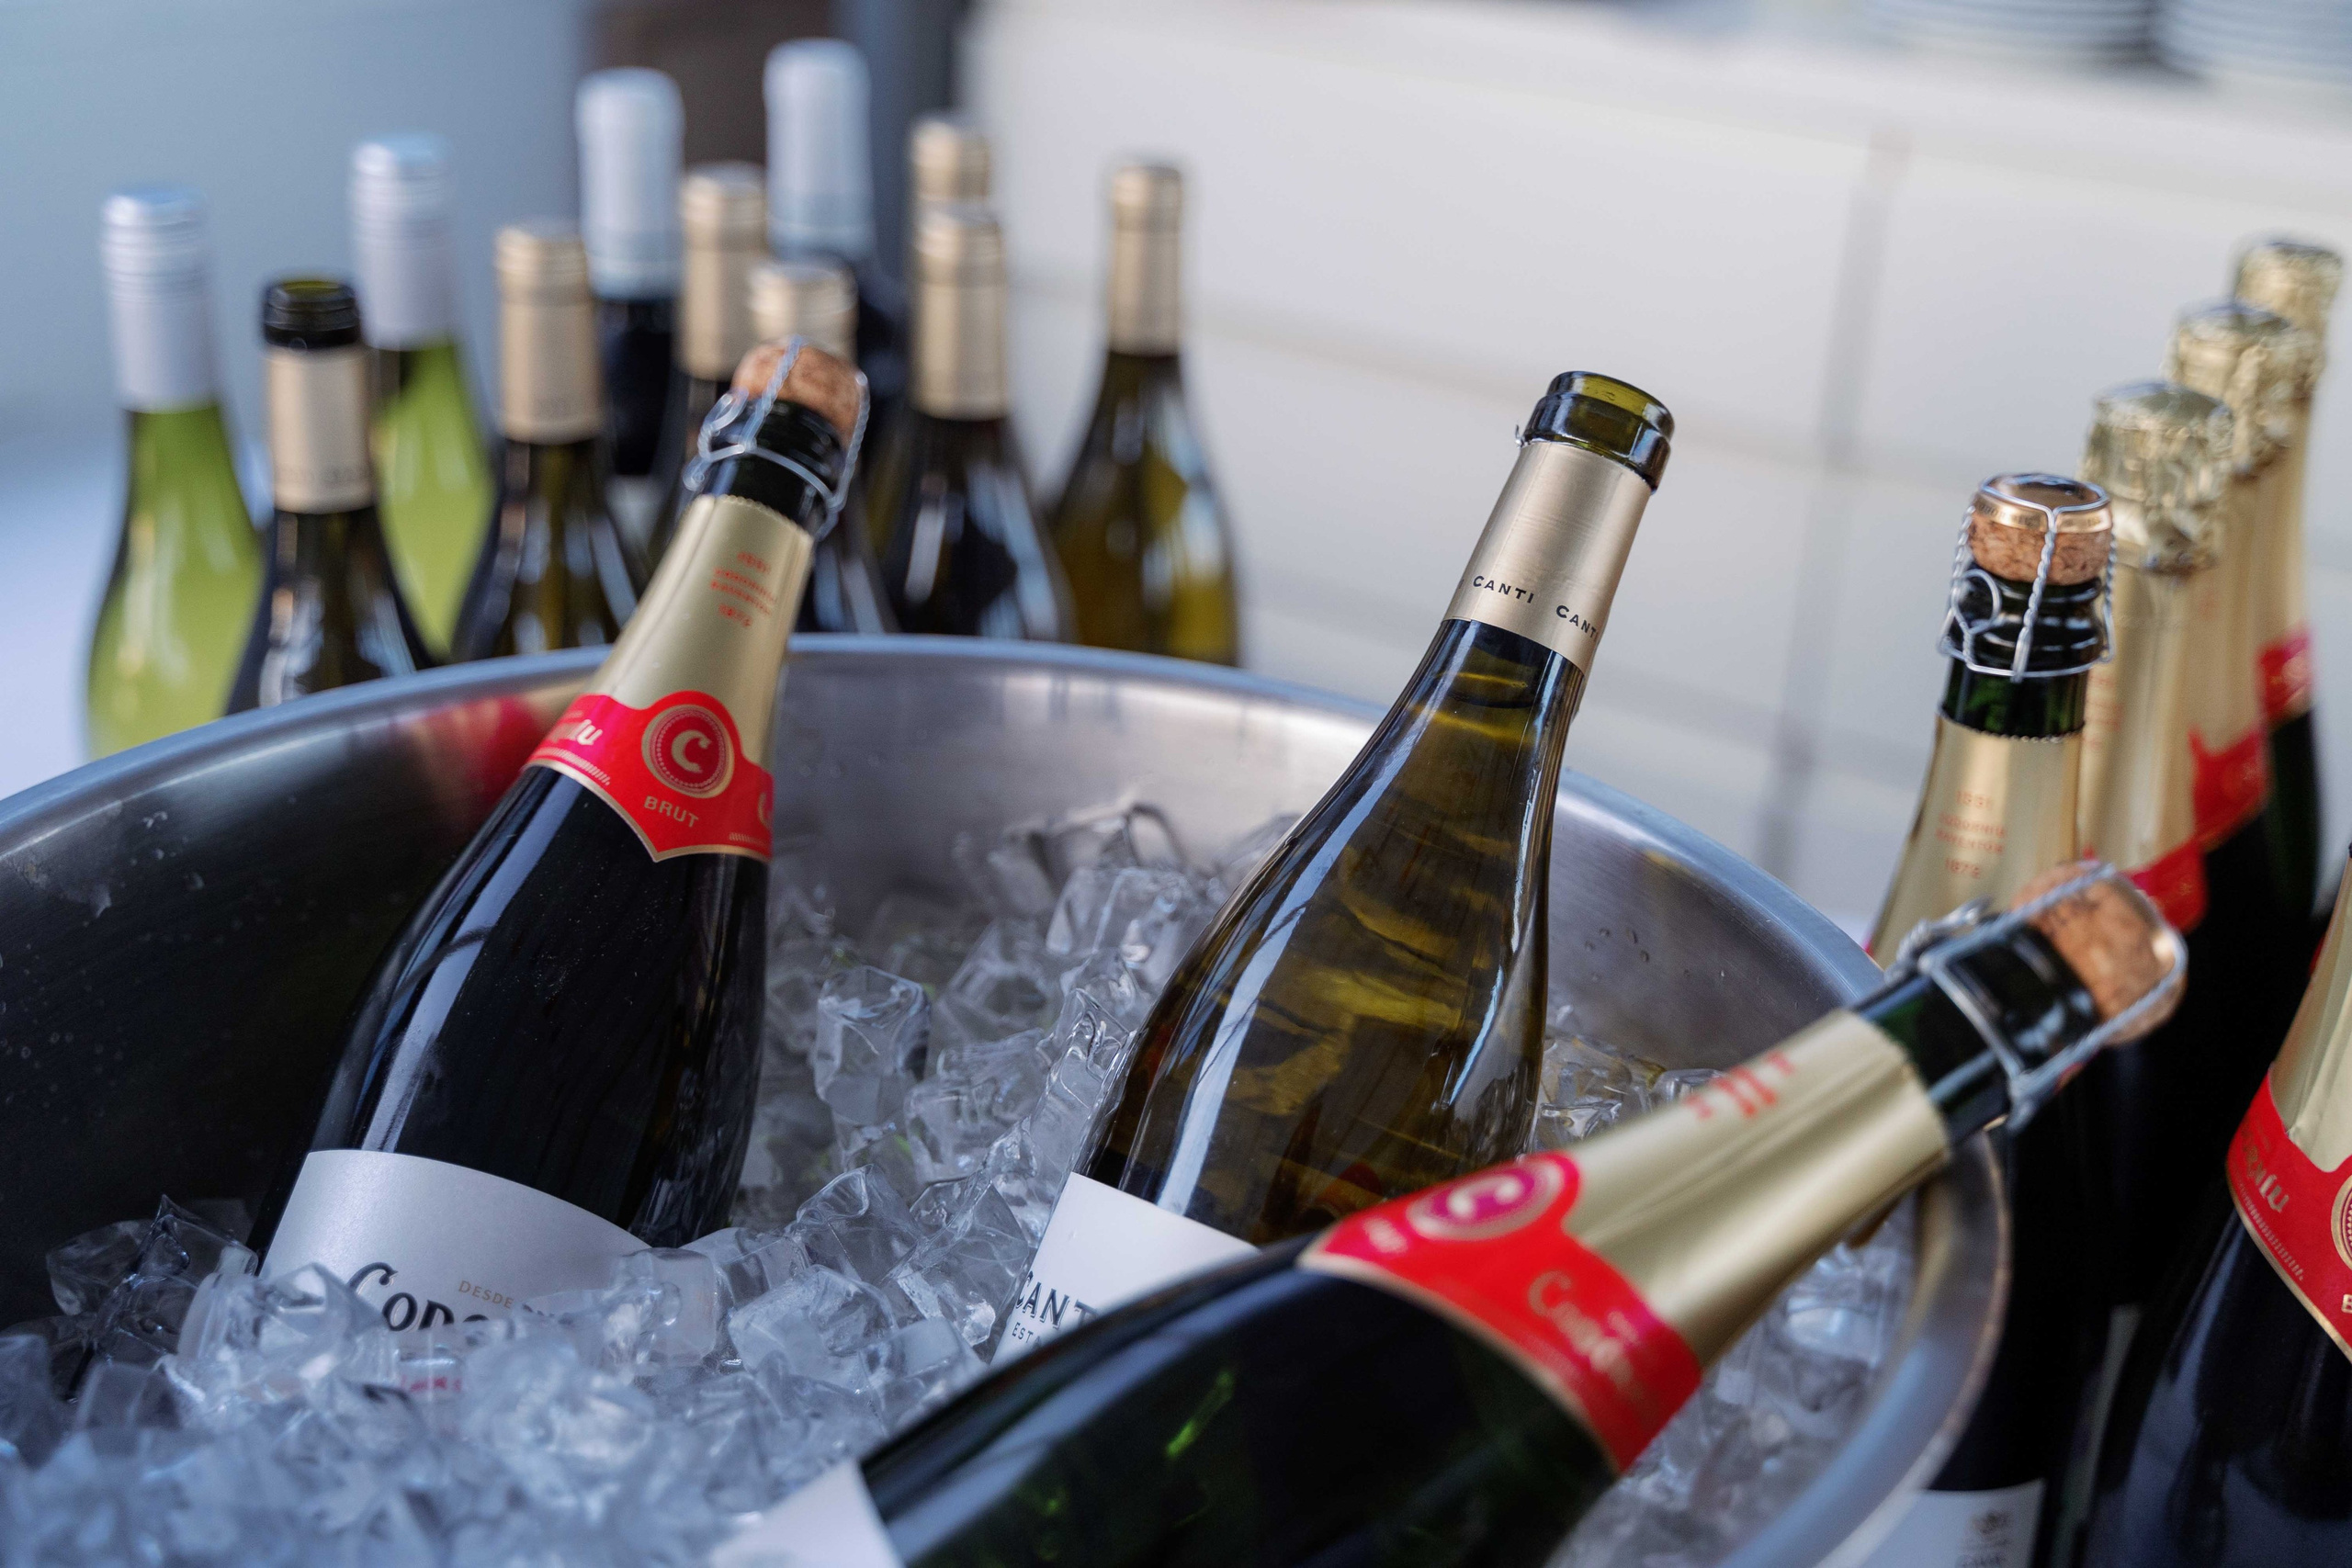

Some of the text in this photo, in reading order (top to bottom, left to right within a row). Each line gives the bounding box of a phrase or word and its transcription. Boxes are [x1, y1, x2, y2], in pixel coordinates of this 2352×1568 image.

[1472, 575, 1534, 604] CANTI
[671, 729, 712, 774] C
[643, 795, 699, 828] BRUT
[458, 1280, 514, 1309] DESDE
